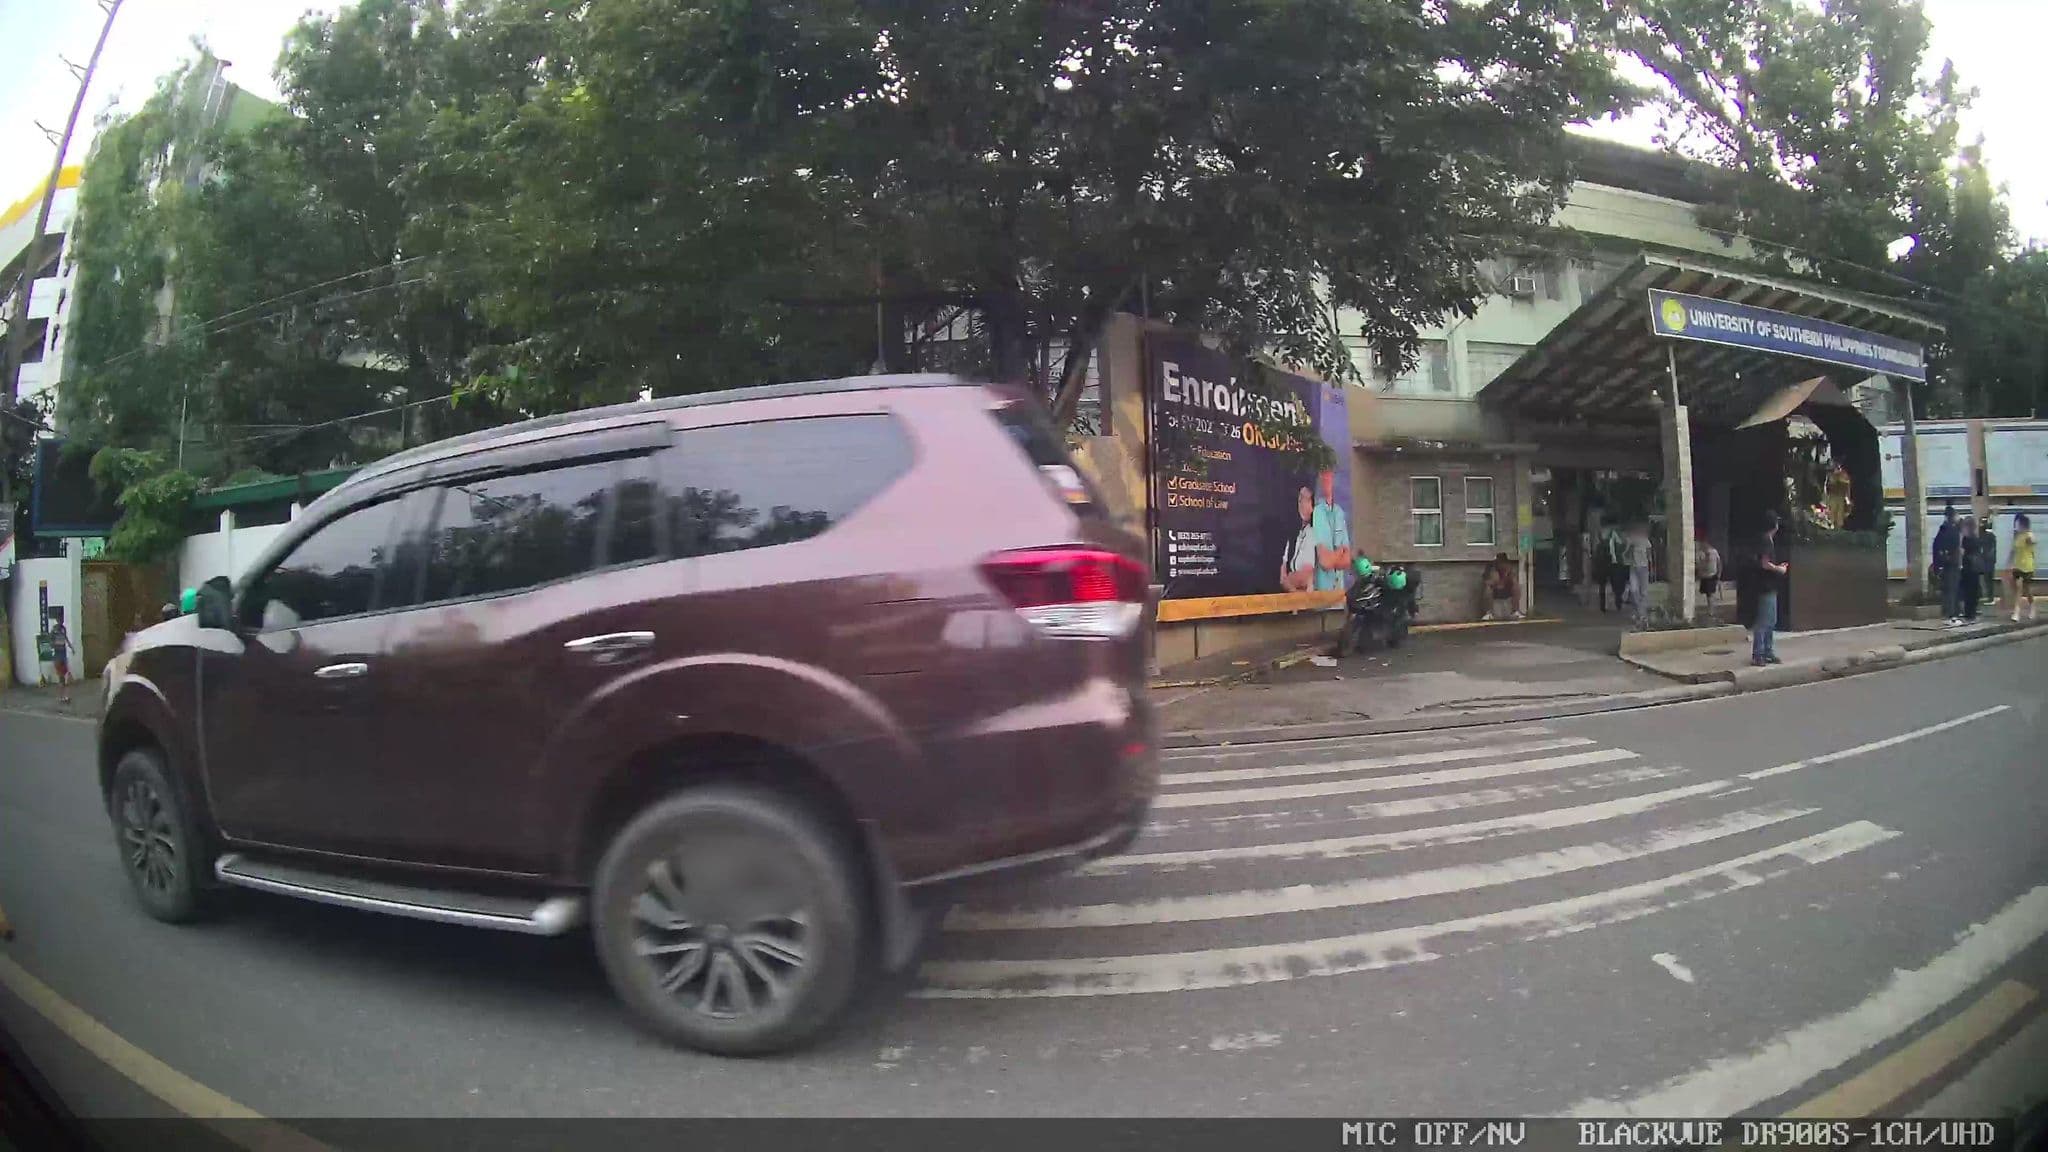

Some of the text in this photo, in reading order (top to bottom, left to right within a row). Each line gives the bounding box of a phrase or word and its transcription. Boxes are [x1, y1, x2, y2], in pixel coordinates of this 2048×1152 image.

[1689, 308, 1754, 335] UNIVERSITY
[1756, 320, 1773, 337] OF
[1772, 324, 1824, 347] SOUTHERN
[1161, 360, 1308, 427] Enrollen
[1178, 477, 1237, 494] Graduate School
[1178, 494, 1229, 510] School of Law
